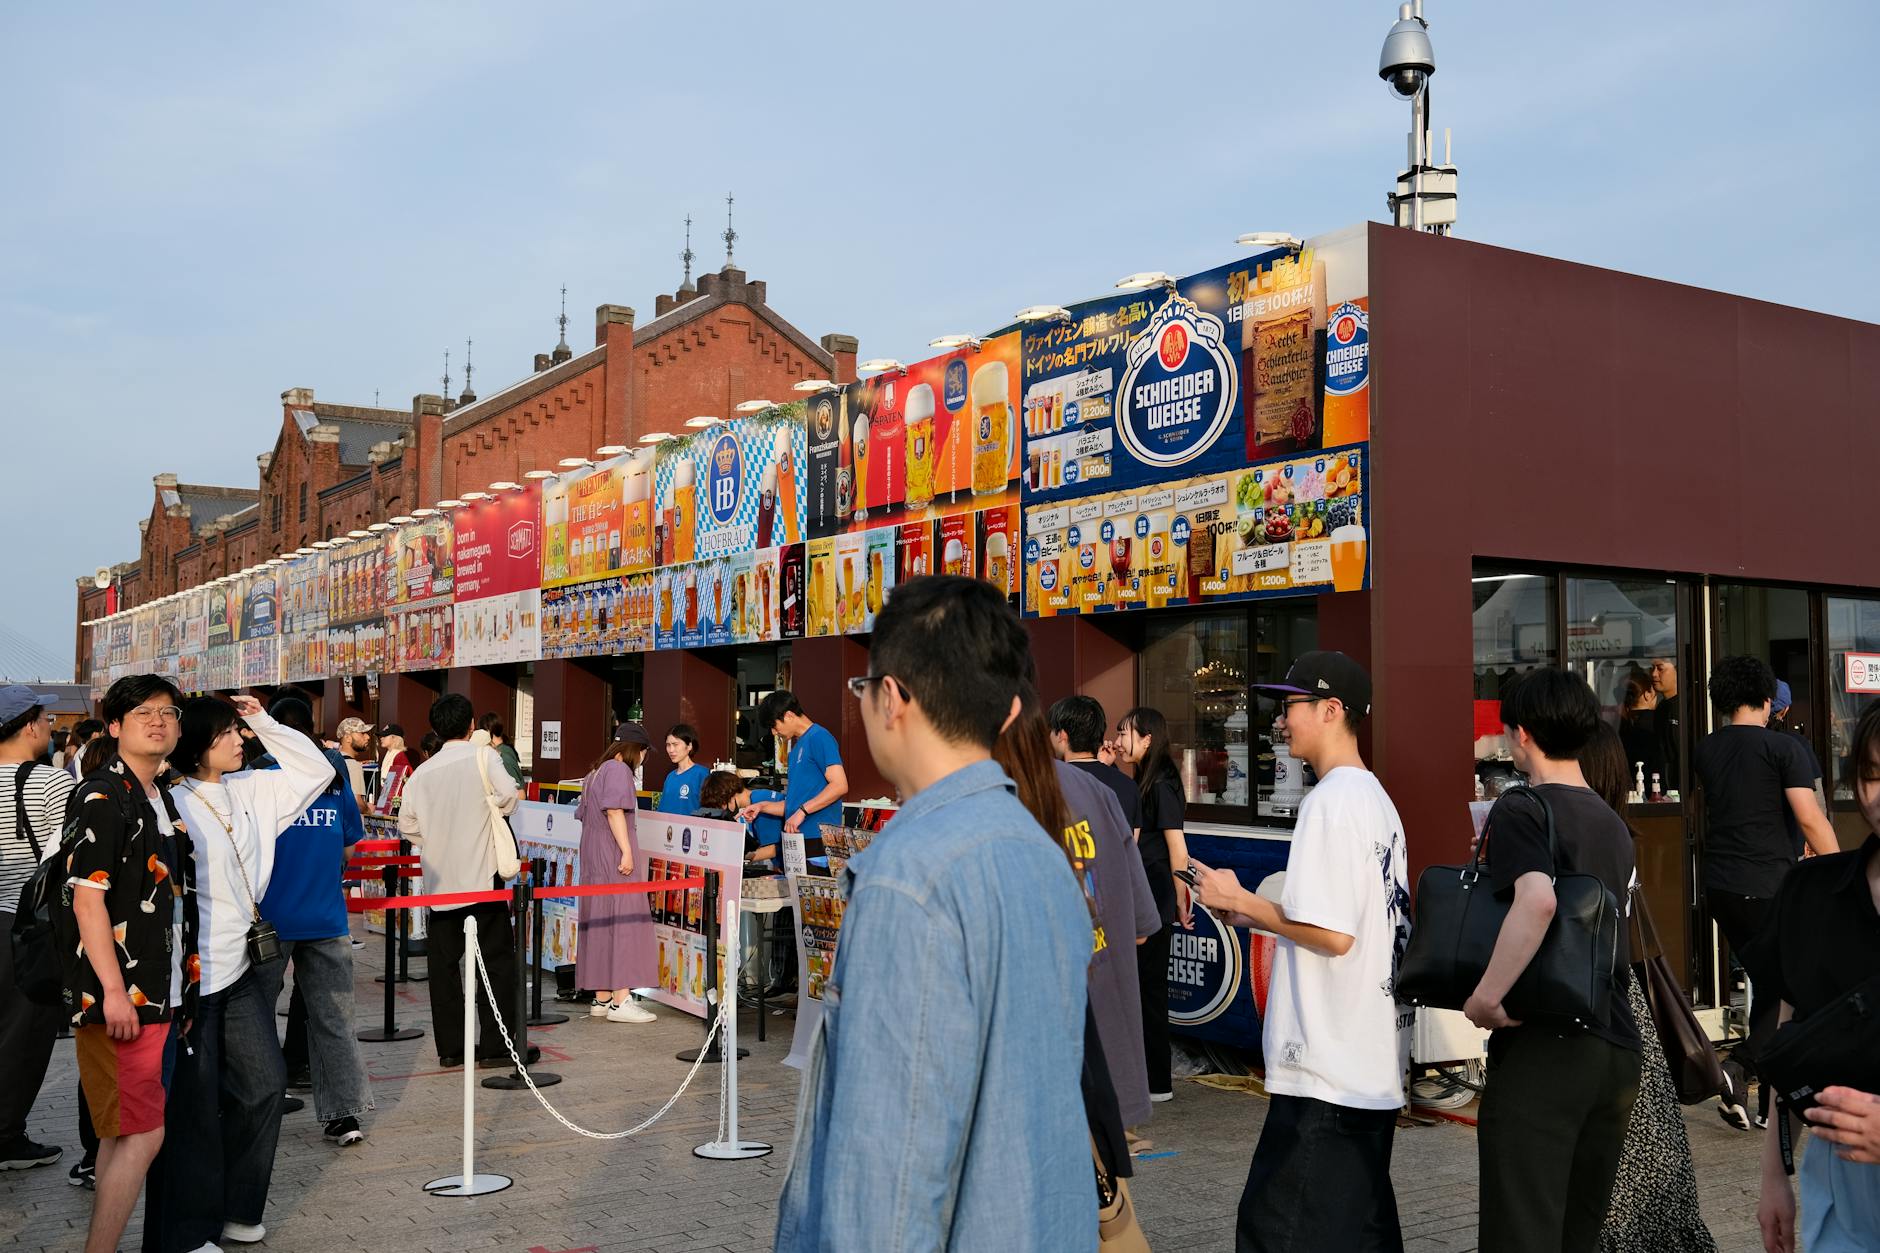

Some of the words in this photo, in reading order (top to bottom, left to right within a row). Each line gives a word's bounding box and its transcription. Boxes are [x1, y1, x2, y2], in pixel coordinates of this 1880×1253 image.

[1227, 248, 1315, 304] 初上陸!!
[1227, 284, 1313, 322] 1日限定100杯!!
[1025, 301, 1154, 353] ヴァイツェン醸造で名高い
[1329, 358, 1353, 377] WEISSE
[1136, 369, 1213, 408] SCHNEIDER
[874, 411, 903, 427] SPATEN
[1148, 397, 1200, 430] WEISSE
[715, 477, 734, 512] HB
[572, 505, 587, 524] THE
[1195, 509, 1220, 524] 1日限定
[703, 526, 745, 552] HOFBRÄU
[1206, 520, 1238, 537] 100杯!!
[1045, 534, 1061, 546] 王道の
[457, 562, 476, 577] brewed
[477, 560, 482, 572] in
